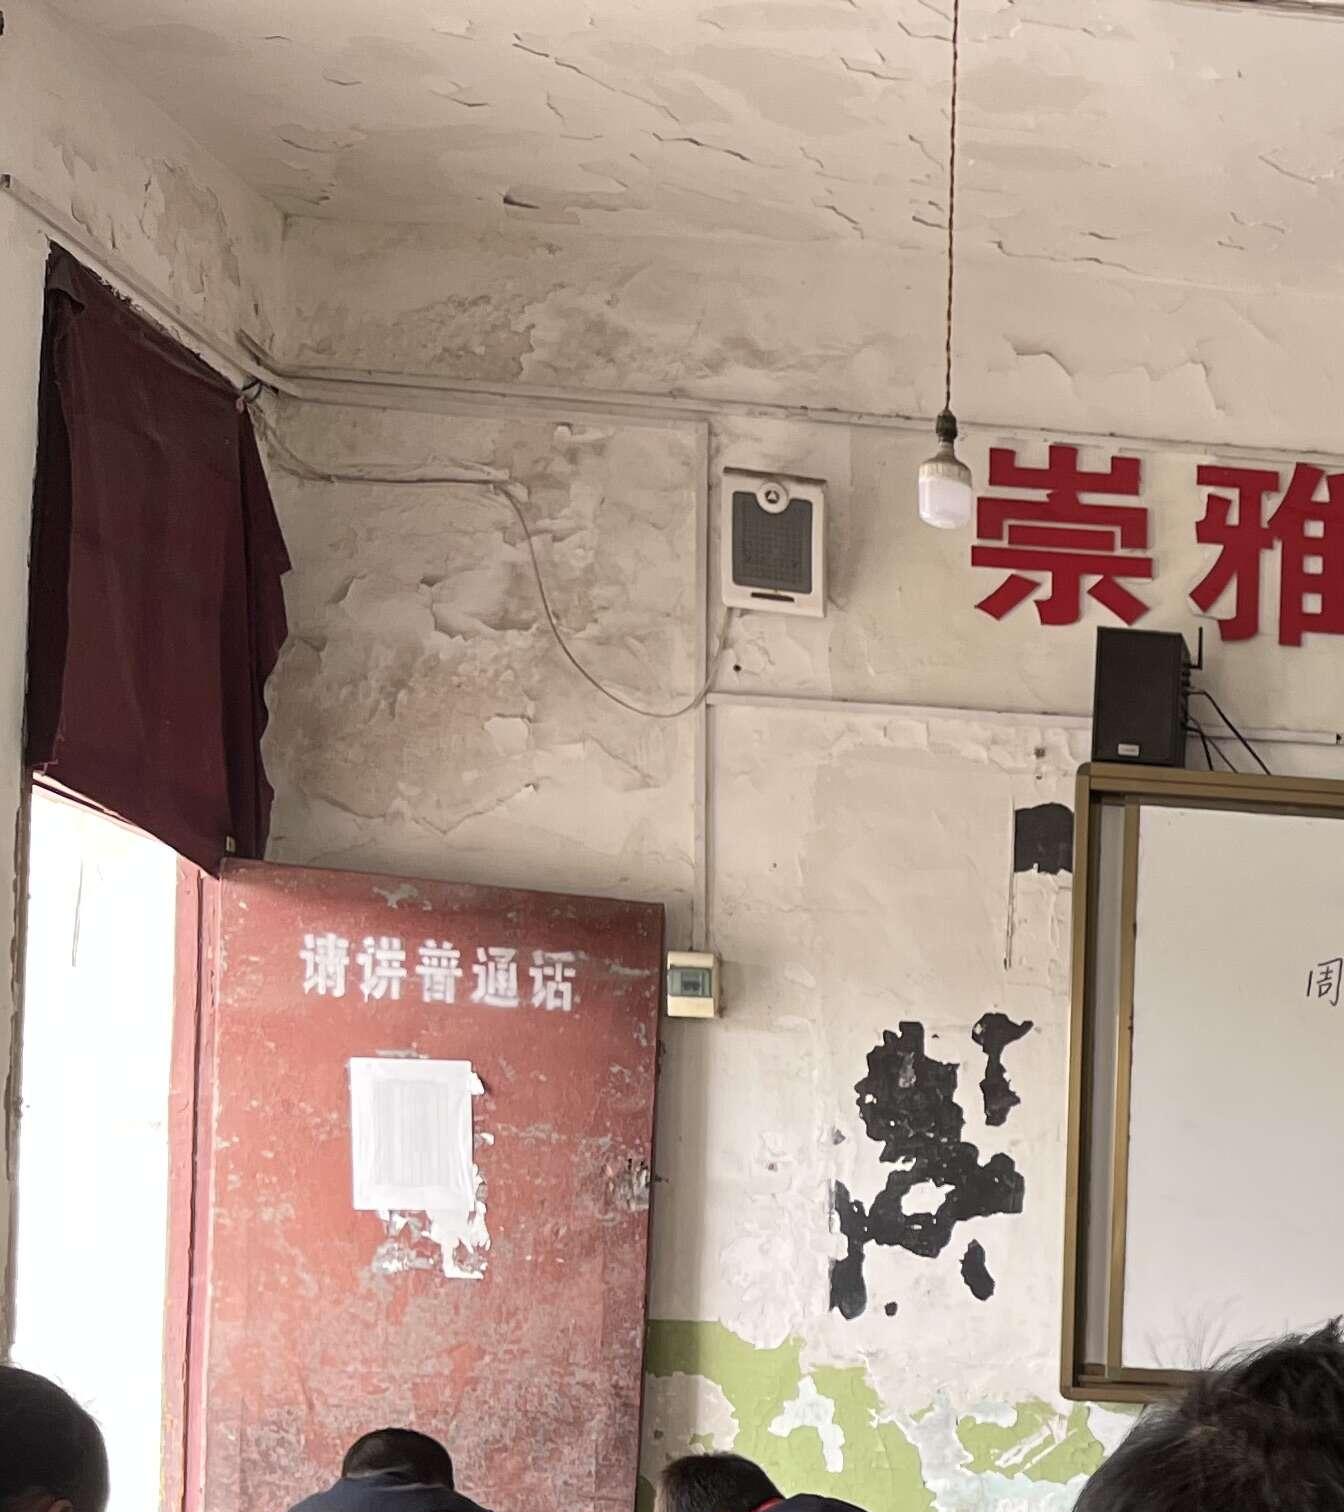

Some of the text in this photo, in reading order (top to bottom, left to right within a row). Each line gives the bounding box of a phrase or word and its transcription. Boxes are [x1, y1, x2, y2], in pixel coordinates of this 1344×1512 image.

[301, 933, 577, 1011] 请讲普通话
